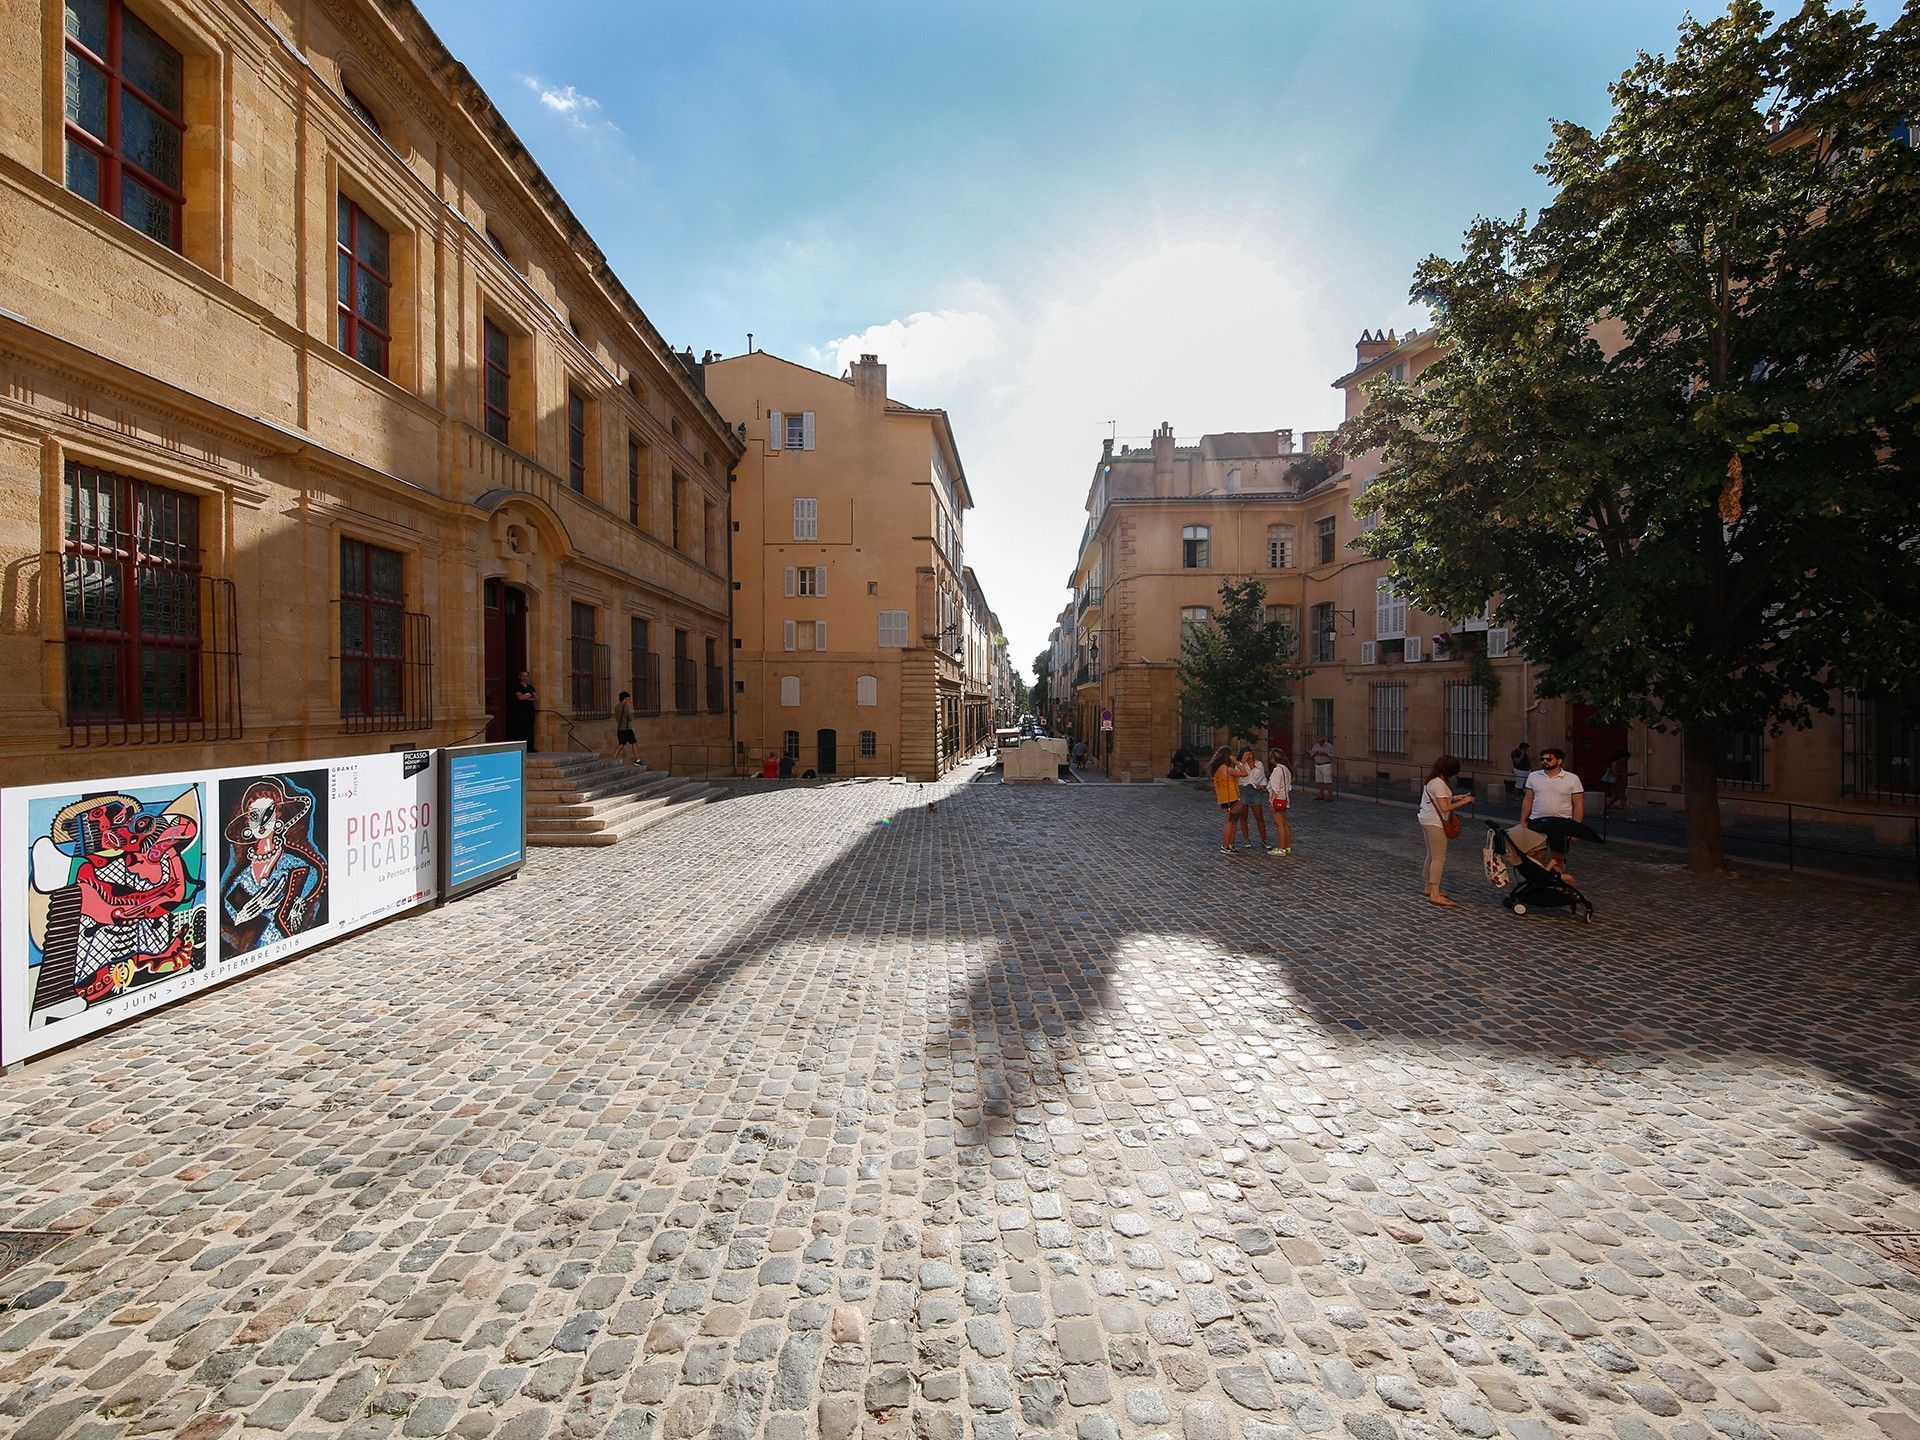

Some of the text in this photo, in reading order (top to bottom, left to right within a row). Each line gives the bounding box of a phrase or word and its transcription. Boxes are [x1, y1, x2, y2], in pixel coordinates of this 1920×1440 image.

[347, 802, 430, 846] PICASSO
[347, 829, 430, 876] PICABIA
[386, 867, 411, 879] Peinture
[105, 1007, 114, 1017] 9
[123, 991, 158, 1011] JUIN
[181, 978, 197, 990] 23
[203, 949, 270, 981] SEPTEMBRE
[275, 939, 300, 954] 2018
